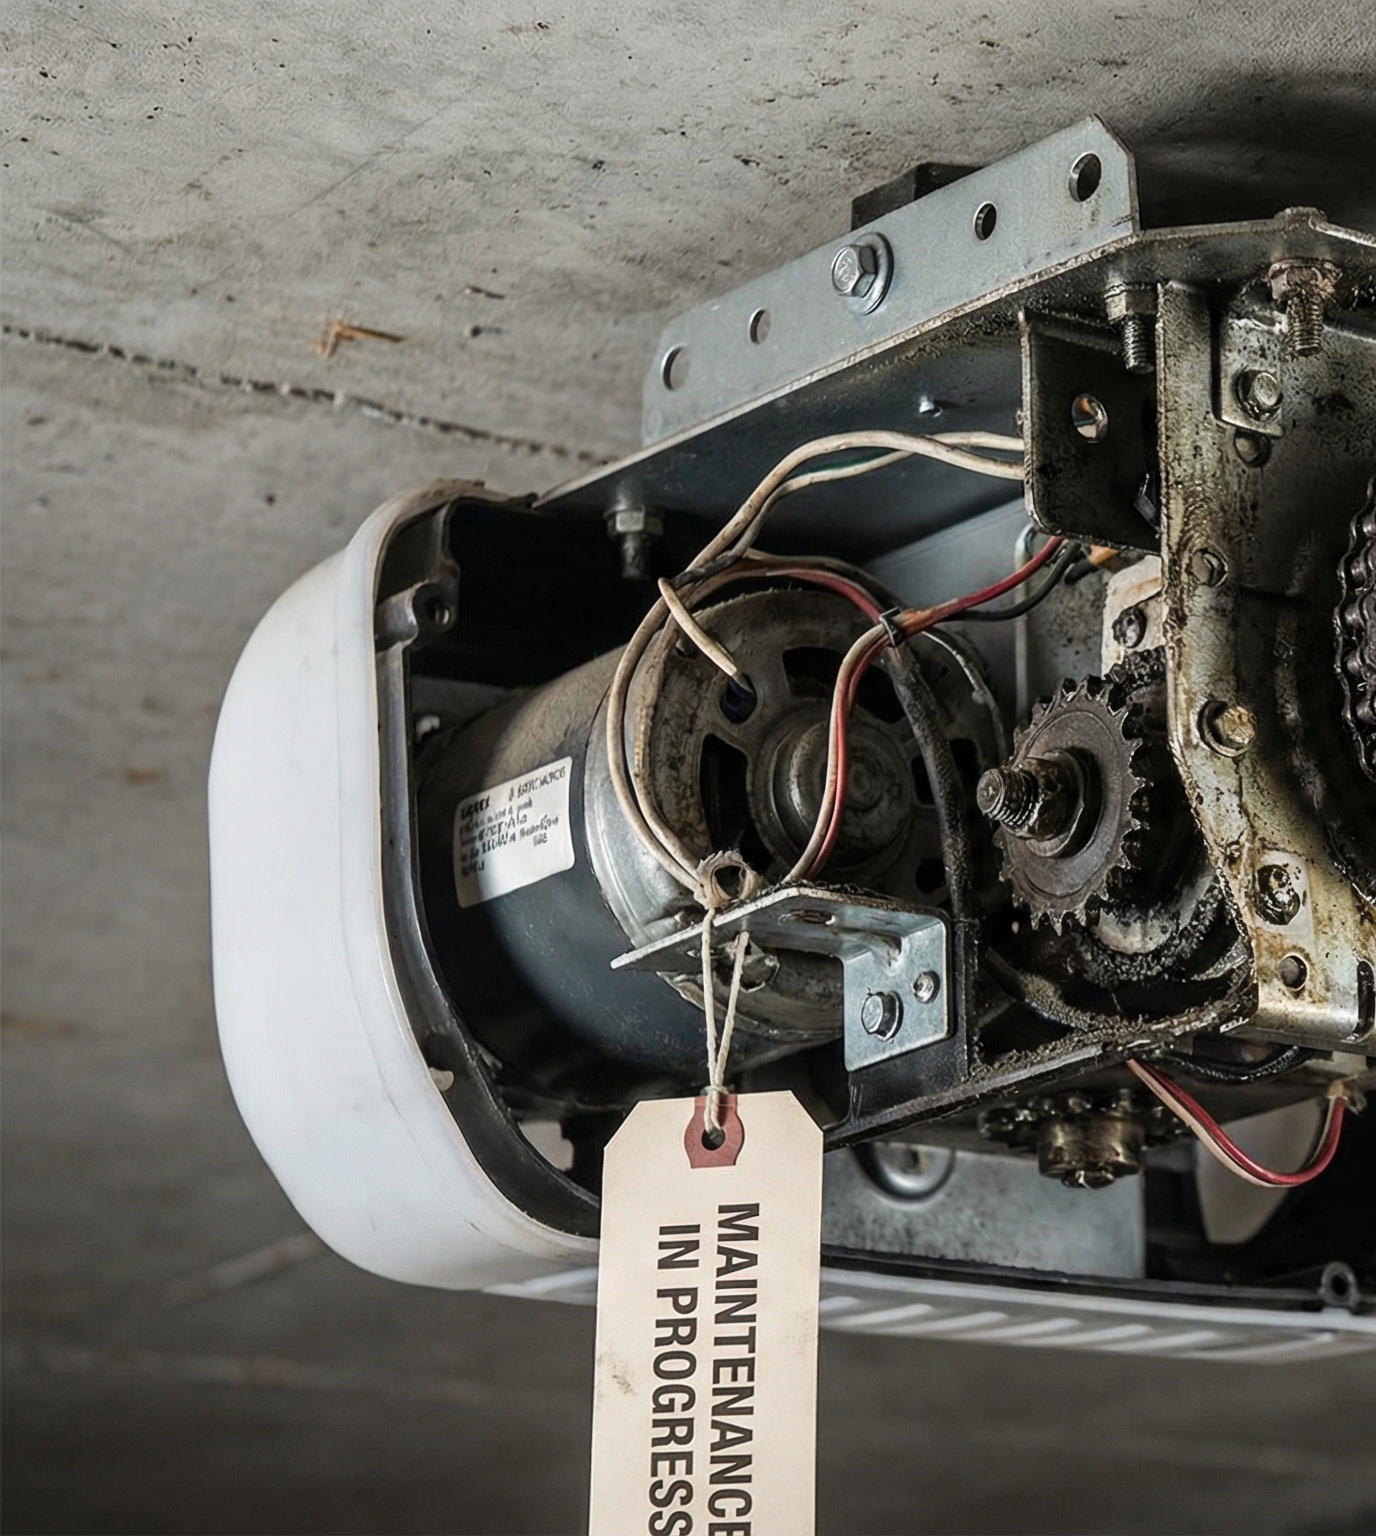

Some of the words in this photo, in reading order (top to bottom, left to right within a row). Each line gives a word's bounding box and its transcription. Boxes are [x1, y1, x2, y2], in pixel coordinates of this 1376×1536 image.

[657, 1223, 701, 1270] IN
[708, 1202, 760, 1536] MAINTENANCE
[648, 1286, 699, 1536] PROGRESS
